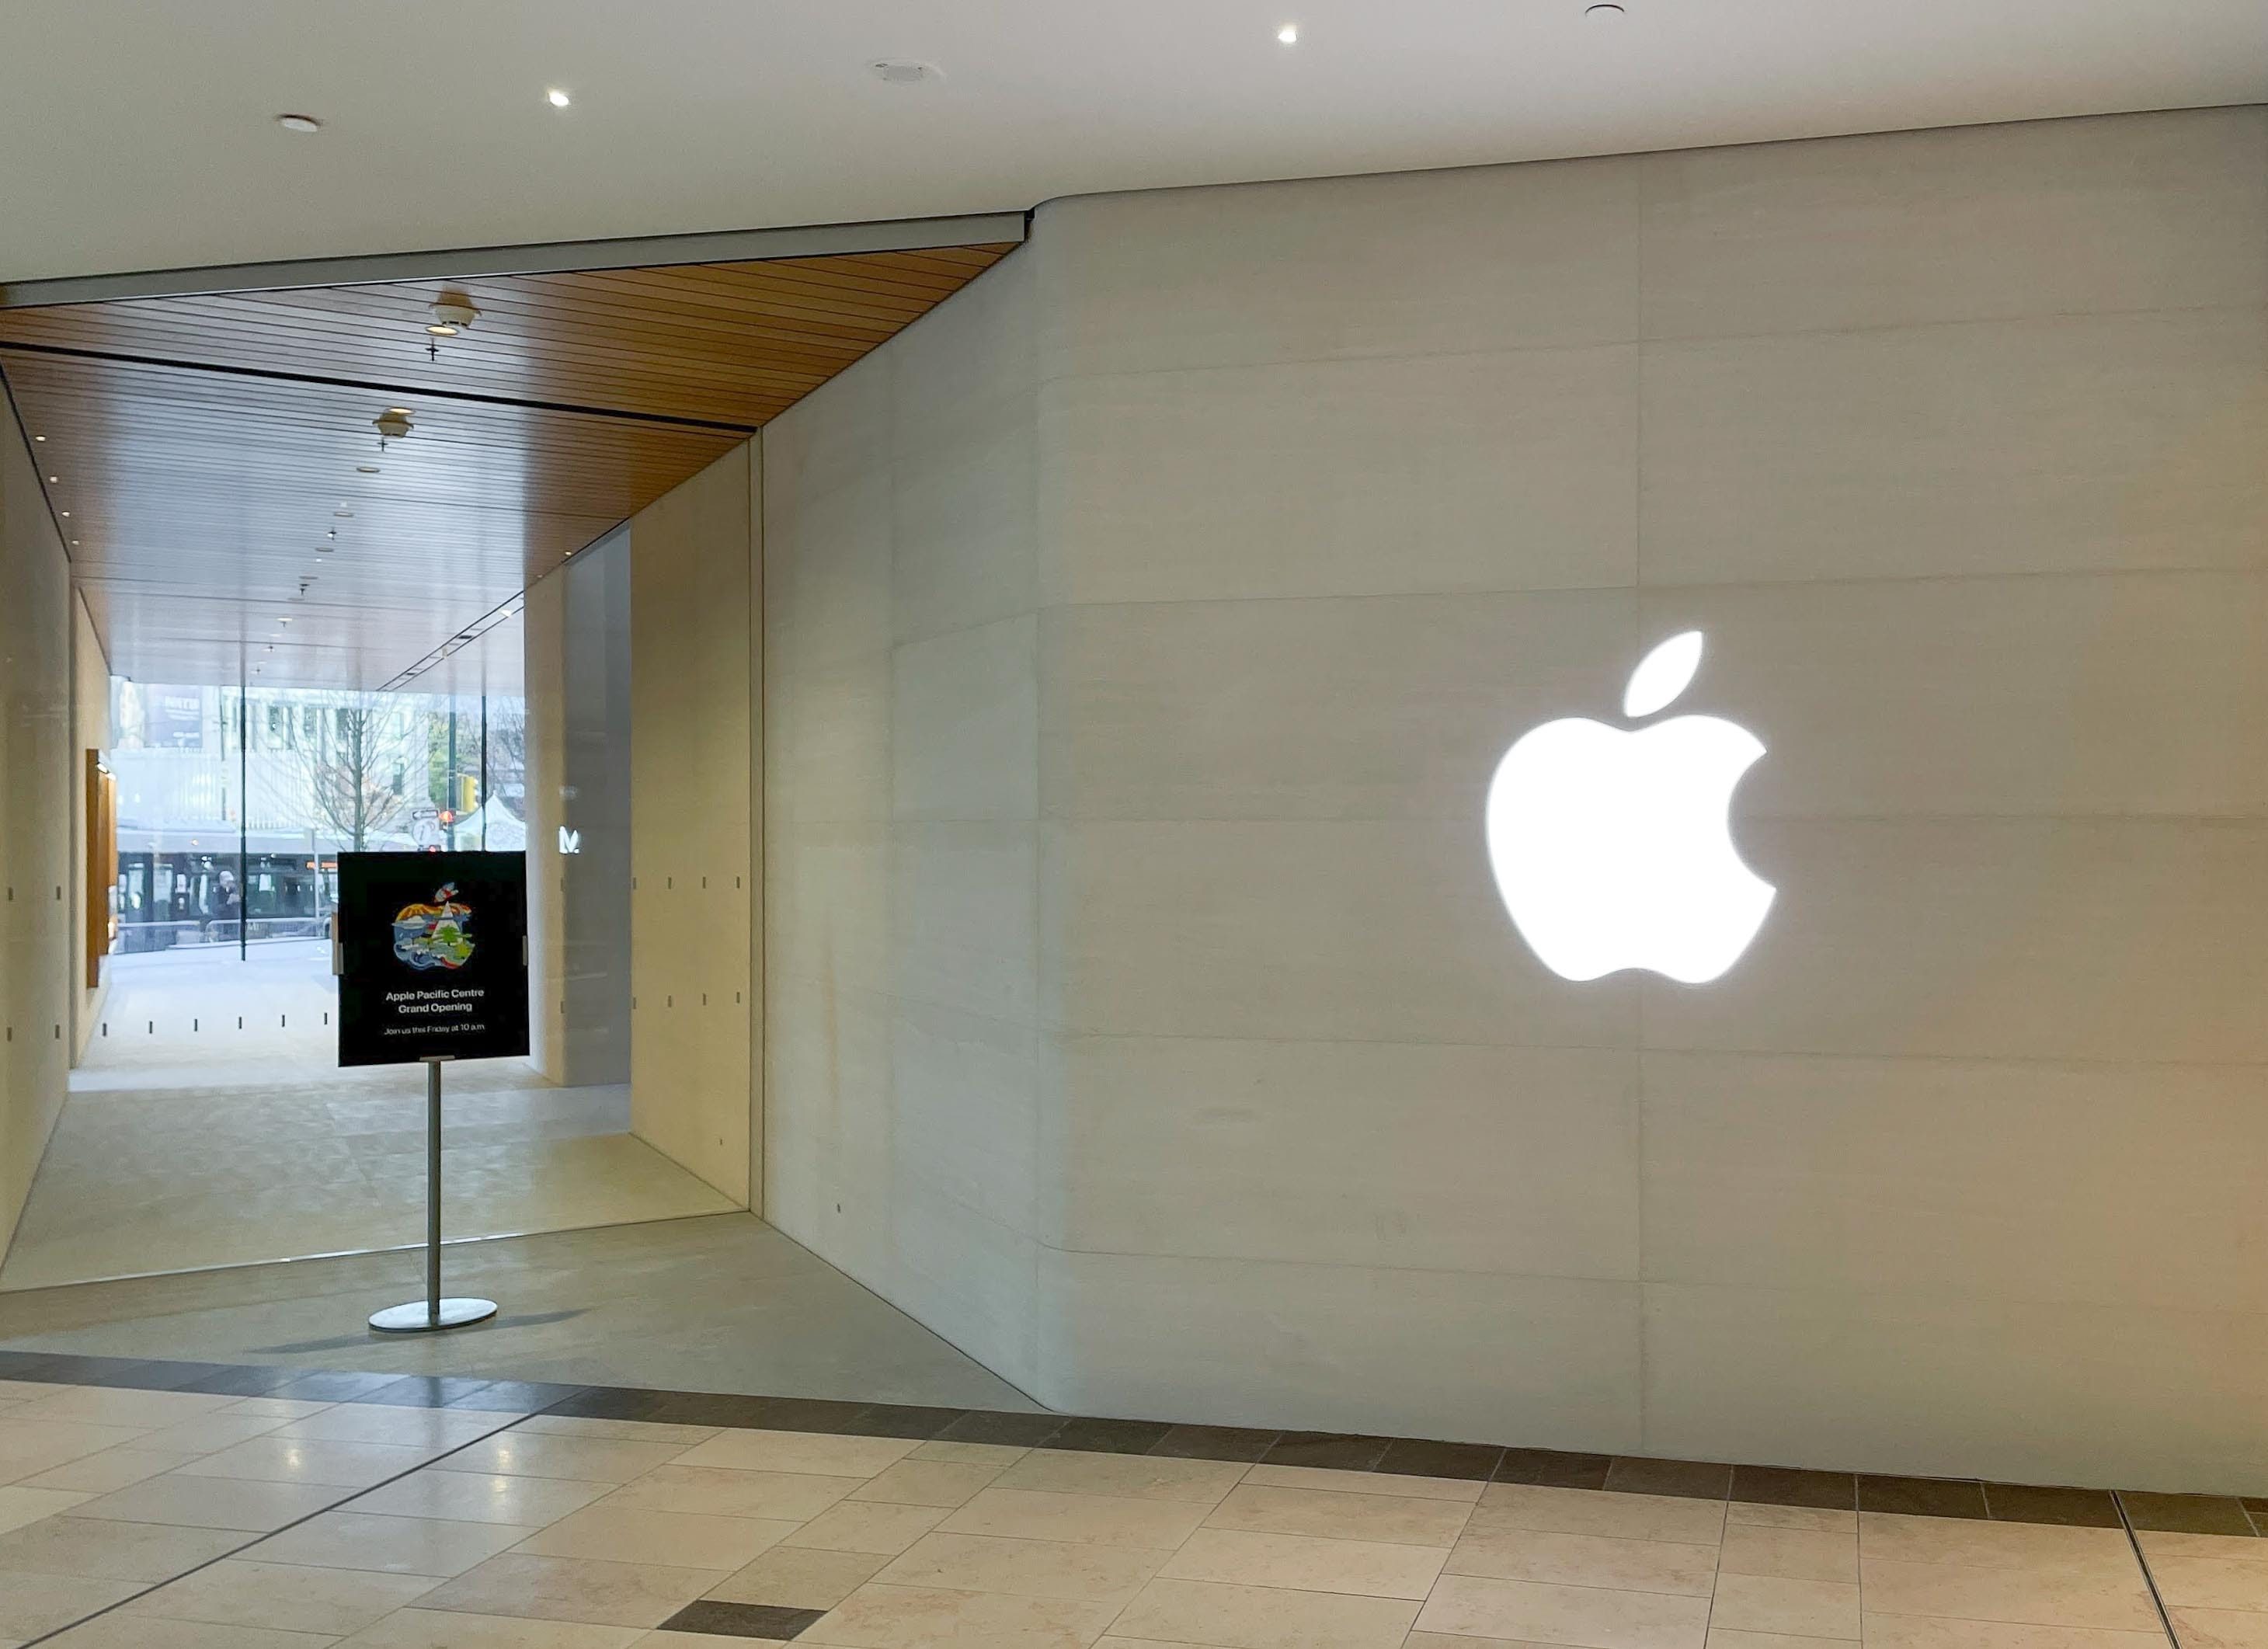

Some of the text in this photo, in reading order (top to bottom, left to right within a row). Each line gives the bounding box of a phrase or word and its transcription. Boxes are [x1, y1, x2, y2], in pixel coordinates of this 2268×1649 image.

[385, 989, 485, 1002] Apple Pacific Centre
[398, 1003, 473, 1013] Grand Opening
